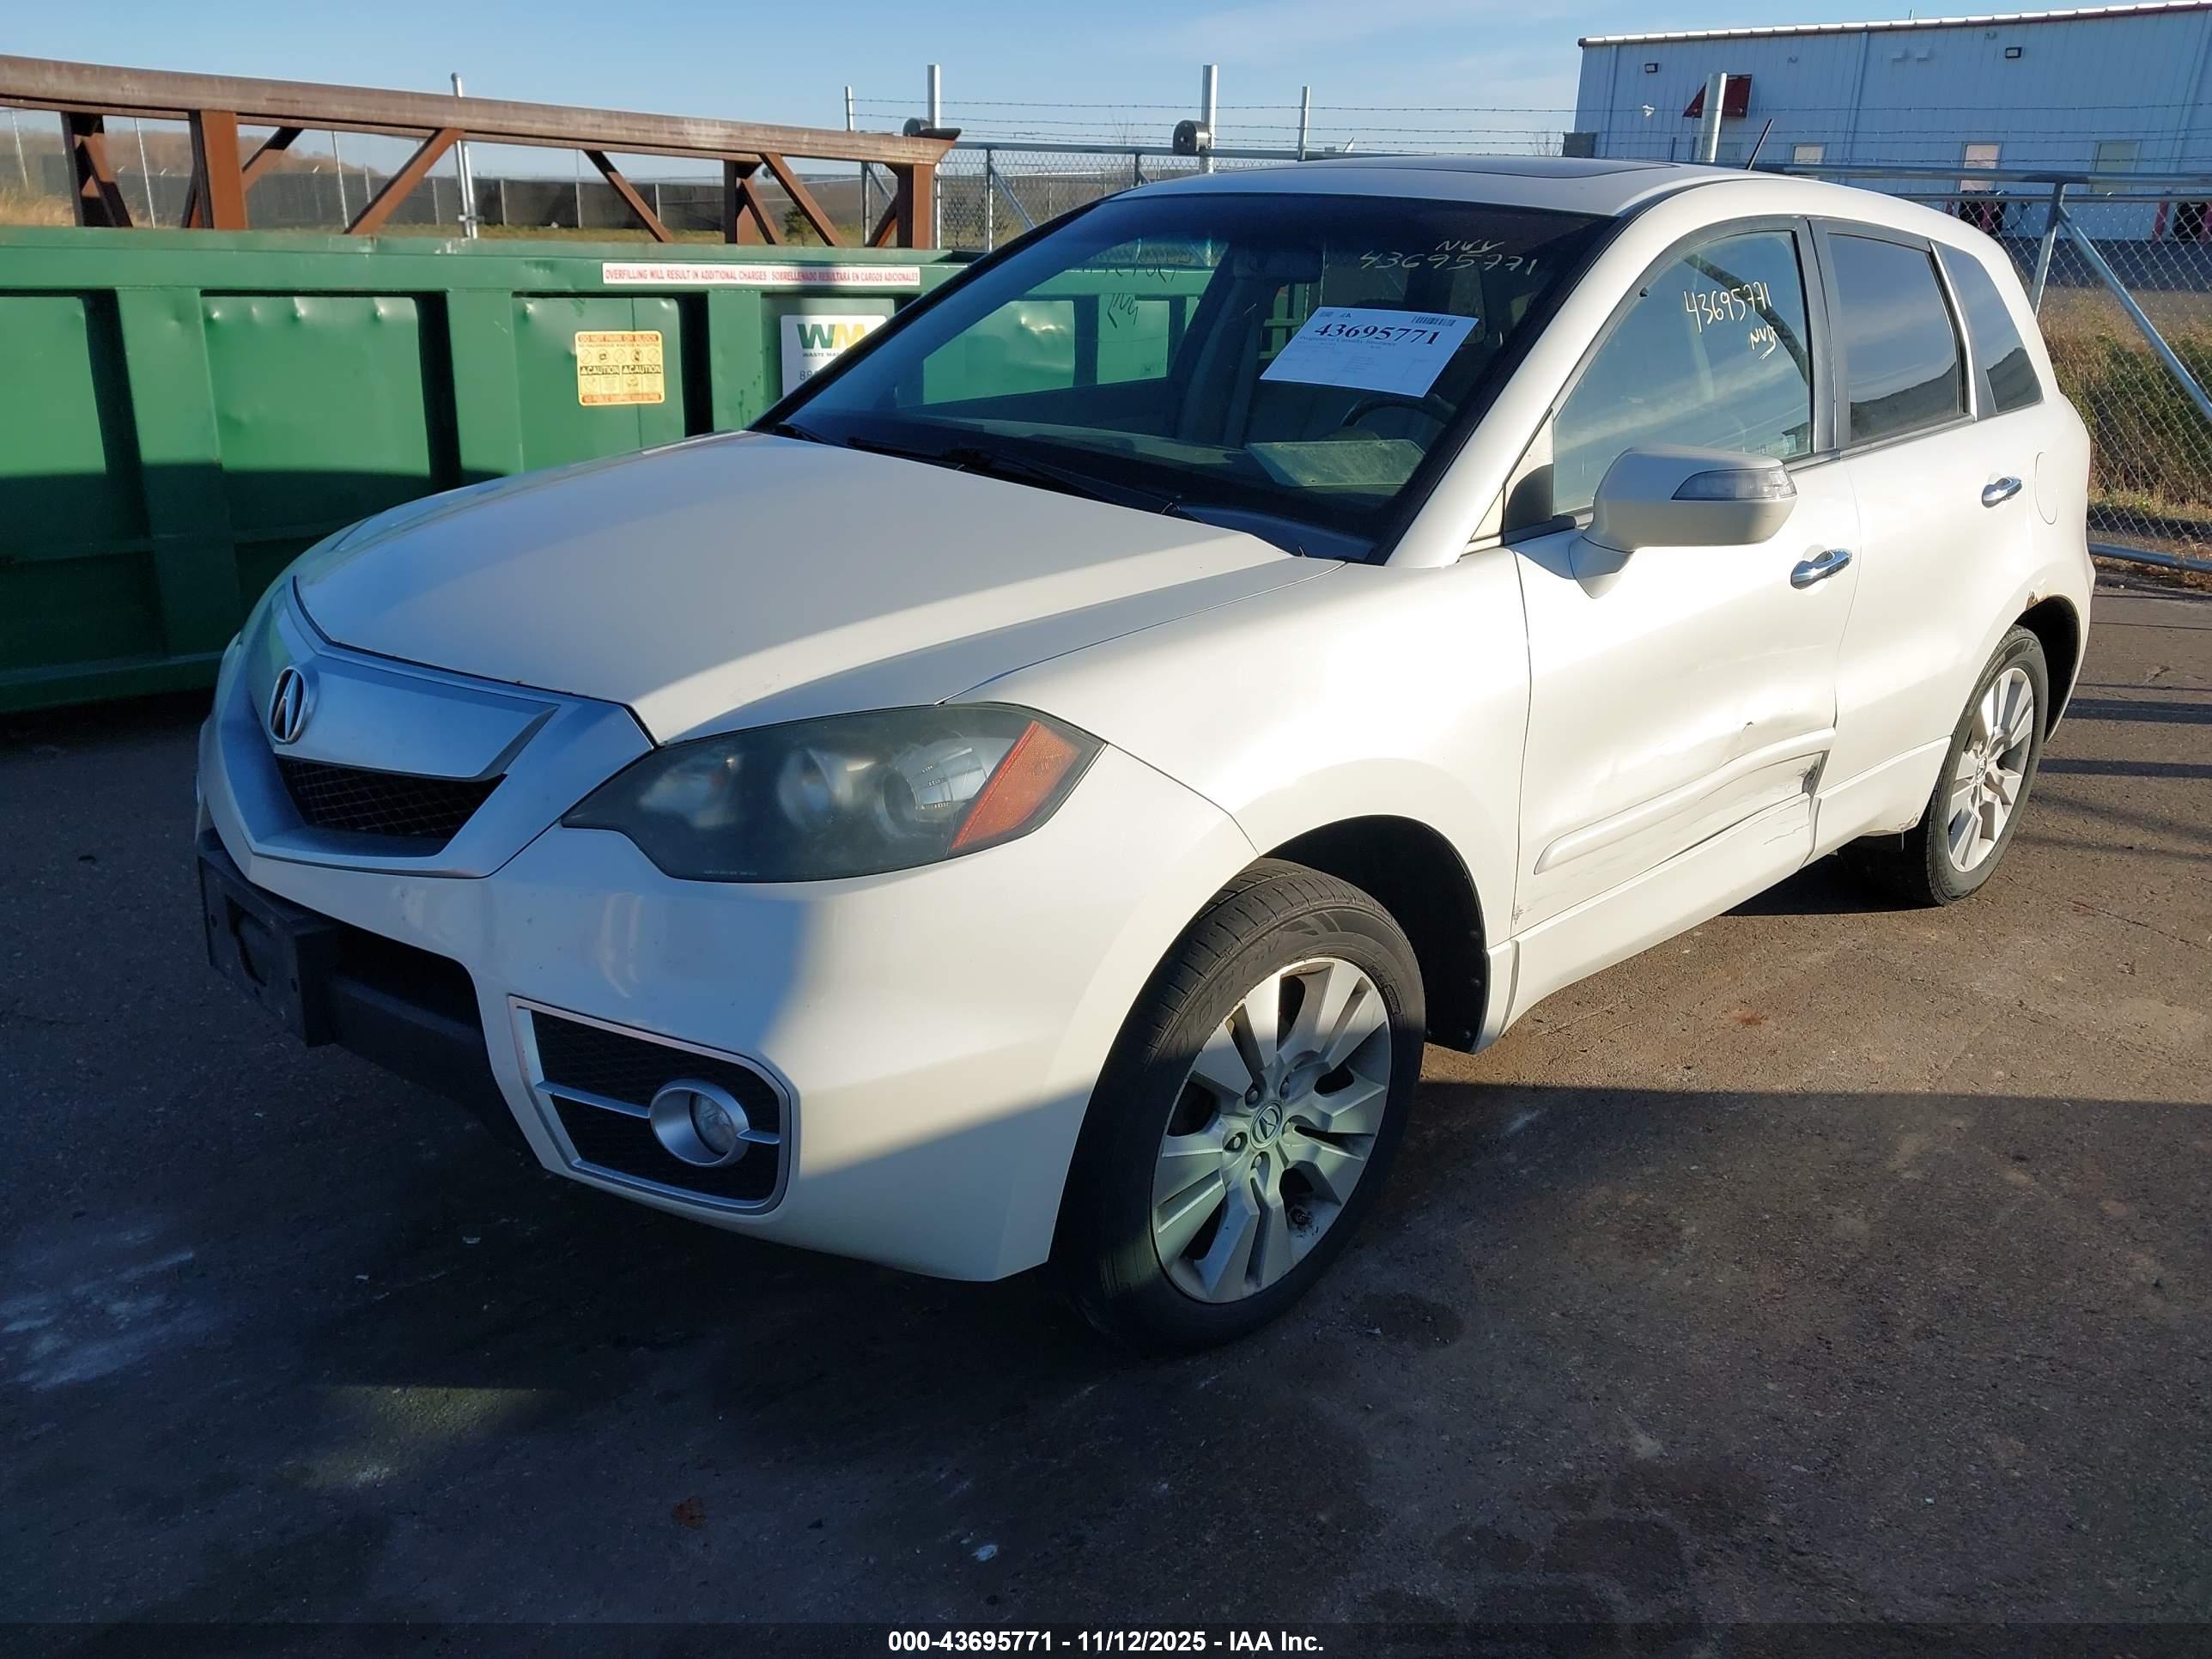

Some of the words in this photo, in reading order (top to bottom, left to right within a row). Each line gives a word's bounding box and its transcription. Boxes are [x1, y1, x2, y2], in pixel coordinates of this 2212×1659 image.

[1360, 251, 1540, 276] 43695771
[605, 268, 647, 281] OVERFILLING
[649, 269, 665, 281] WILL
[666, 269, 690, 281] RESULT
[691, 270, 699, 281] IN
[701, 269, 738, 282] ADDITIONAL
[739, 270, 767, 282] CHARGES
[860, 270, 883, 283] CARGOS
[884, 270, 919, 283] ADICIONALES
[1684, 282, 1772, 333] 43695771
[796, 323, 866, 349] WM
[1314, 322, 1443, 345] 43695771
[586, 365, 620, 375] CAUTION
[629, 364, 661, 374] CAUTION
